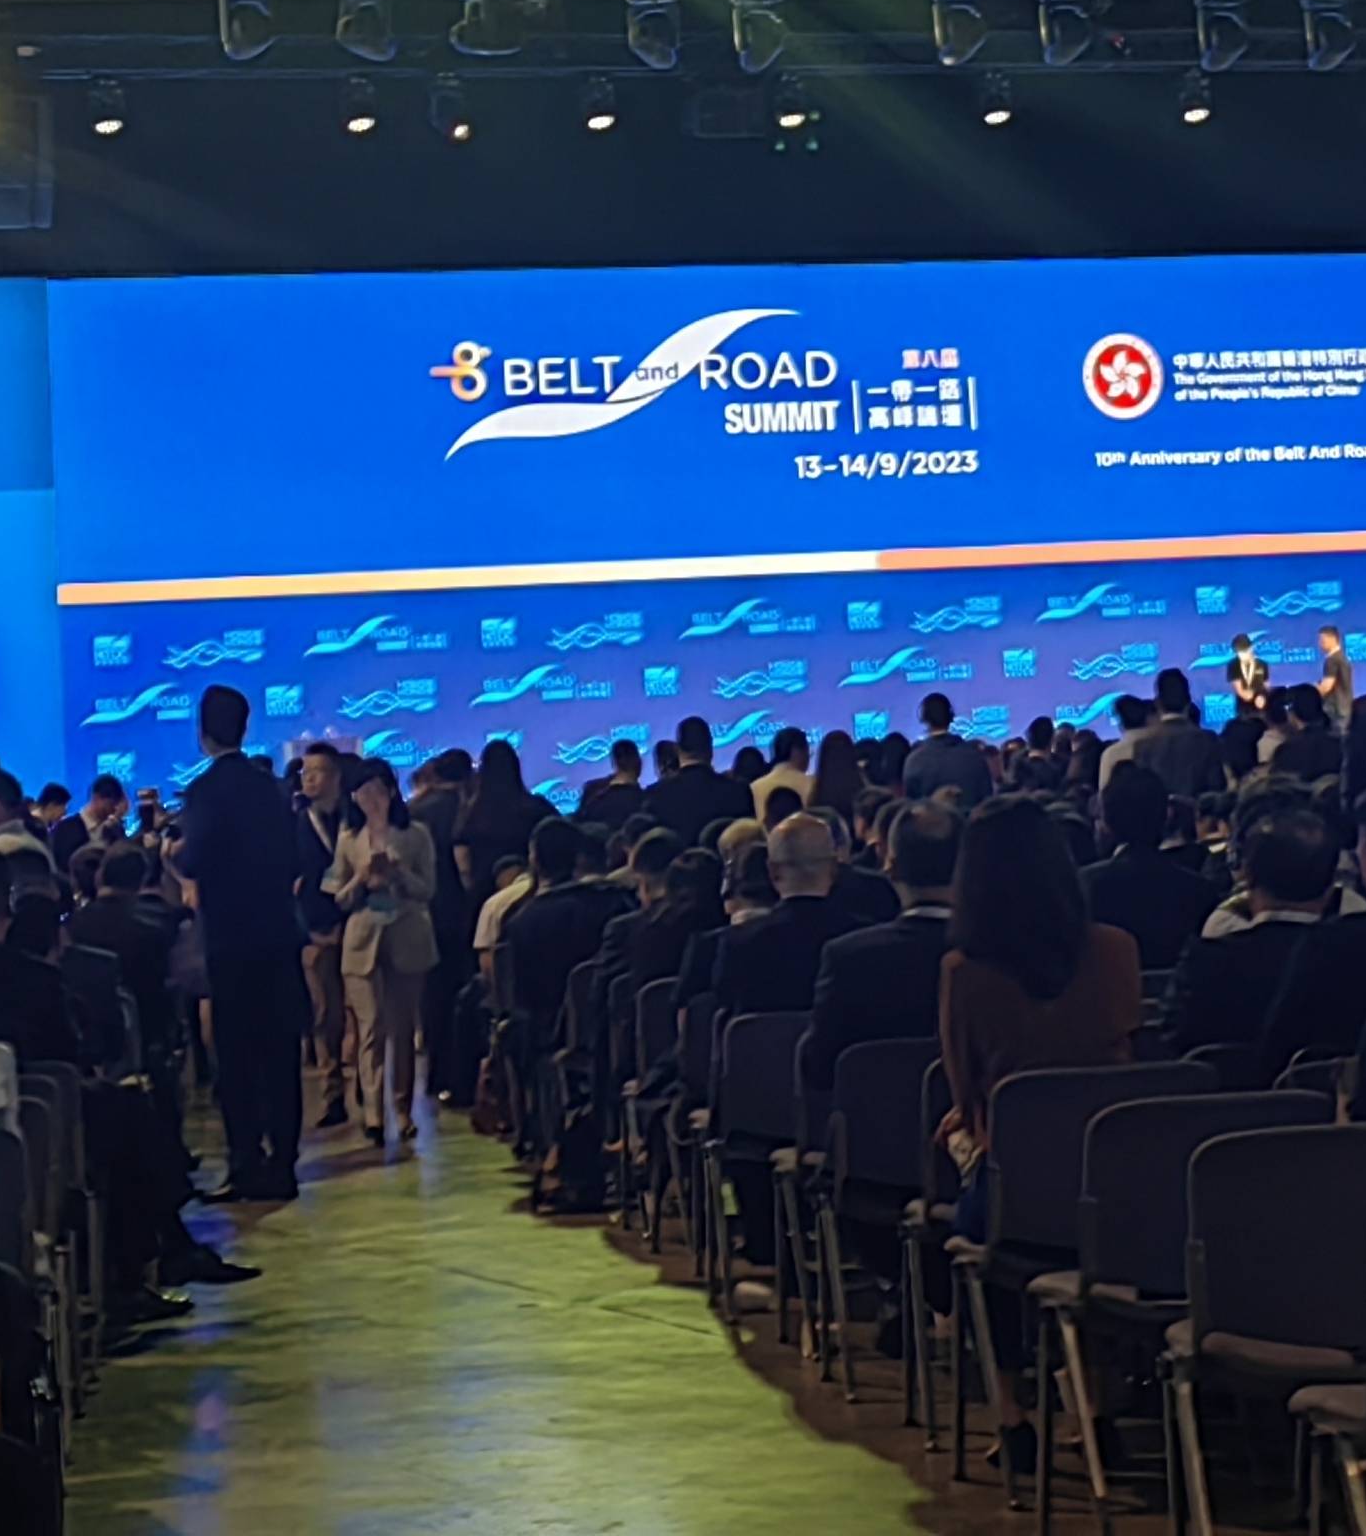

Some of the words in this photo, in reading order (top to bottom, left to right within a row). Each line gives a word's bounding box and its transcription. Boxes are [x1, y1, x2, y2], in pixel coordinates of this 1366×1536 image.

[503, 356, 621, 396] BELT
[634, 362, 679, 382] and
[699, 351, 838, 391] ROAD
[1303, 369, 1333, 384] Hong
[724, 401, 841, 434] SUMMIT
[1129, 448, 1222, 466] Anniversary
[1224, 446, 1242, 462] of
[1245, 447, 1270, 462] the
[1273, 445, 1306, 461] Belt
[1309, 445, 1341, 460] And
